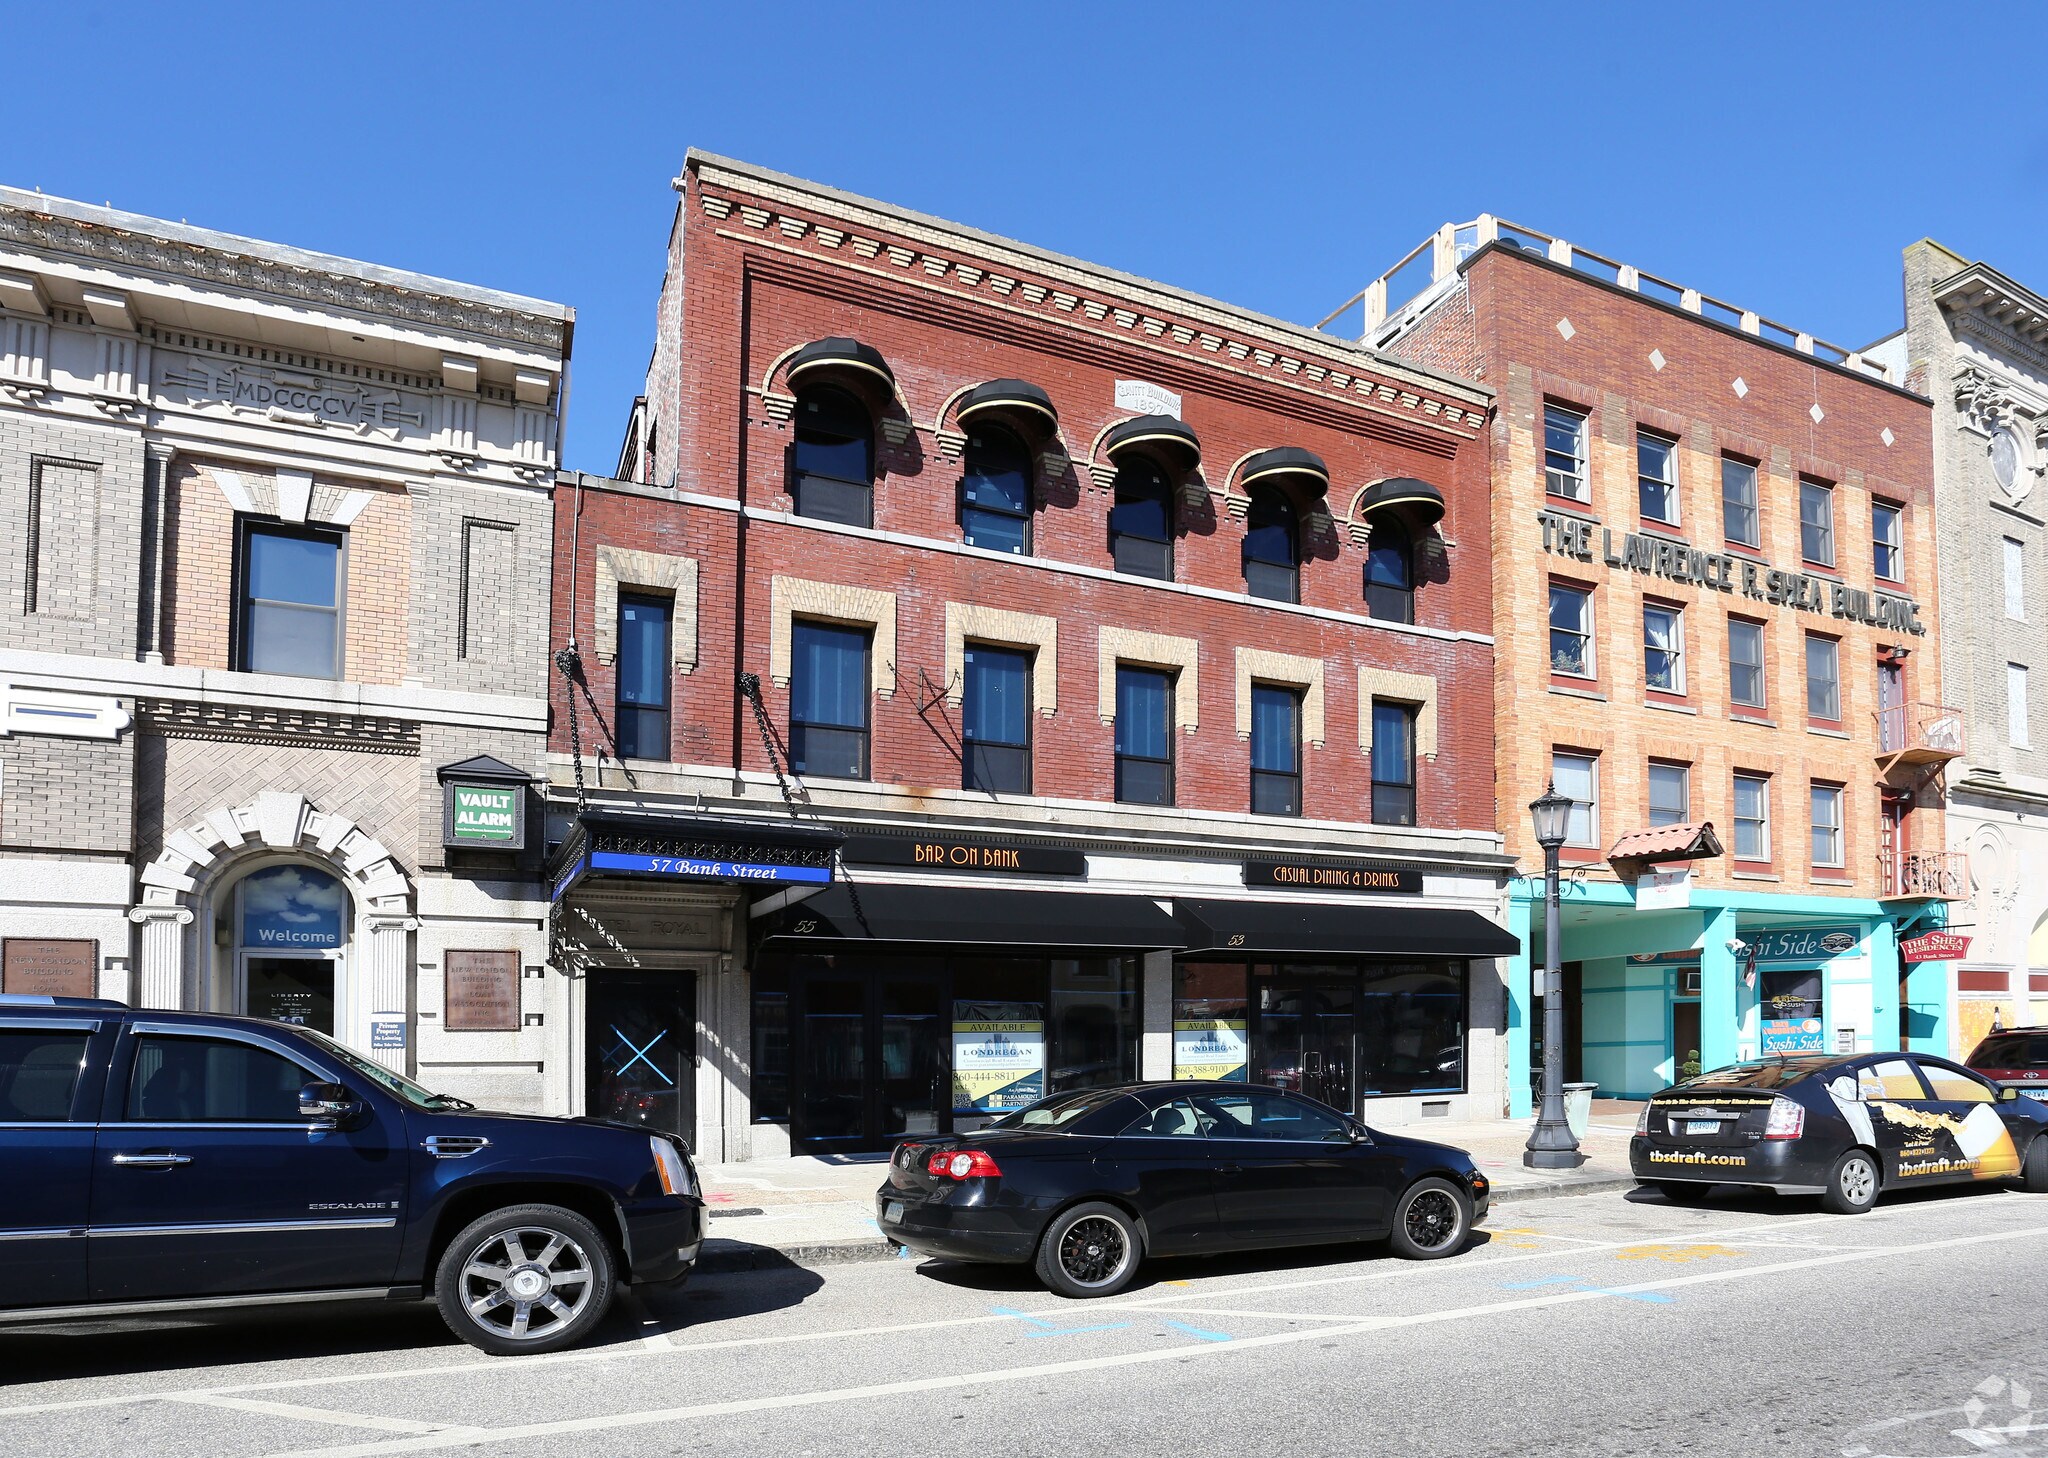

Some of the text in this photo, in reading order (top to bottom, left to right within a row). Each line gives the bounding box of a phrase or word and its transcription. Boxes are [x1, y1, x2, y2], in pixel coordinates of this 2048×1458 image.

[236, 381, 355, 417] MDCCCCV
[1135, 400, 1163, 414] 1897
[1537, 511, 1592, 562] THE
[1603, 528, 1734, 593] LAWRENCE
[1767, 569, 1823, 614] SHEA
[459, 793, 510, 808] VAULT
[457, 811, 511, 826] ALARM
[915, 844, 1020, 868] BAR ON BANK
[647, 859, 670, 873] 57
[728, 864, 777, 880] Street
[1273, 866, 1399, 888] CASUAL DINING & DRINKS
[794, 920, 817, 933] 55
[259, 929, 336, 943] Welcome
[1228, 934, 1245, 946] 53
[1775, 932, 1817, 956] Side
[1906, 938, 1929, 949] THE
[1908, 944, 1964, 955] RESIDENCES
[970, 1023, 1026, 1031] AVAILABLE
[1188, 1022, 1233, 1030] AVAILABLE
[1764, 1035, 1823, 1050] Sushi Side
[953, 1071, 1016, 1081] 860-444-8811
[1175, 1066, 1228, 1075] 860-388-9100
[1650, 1150, 1746, 1166] tbsdraft.com
[1899, 1157, 1980, 1177] tbsdraft.com
[309, 1202, 386, 1210] ESCALADE
